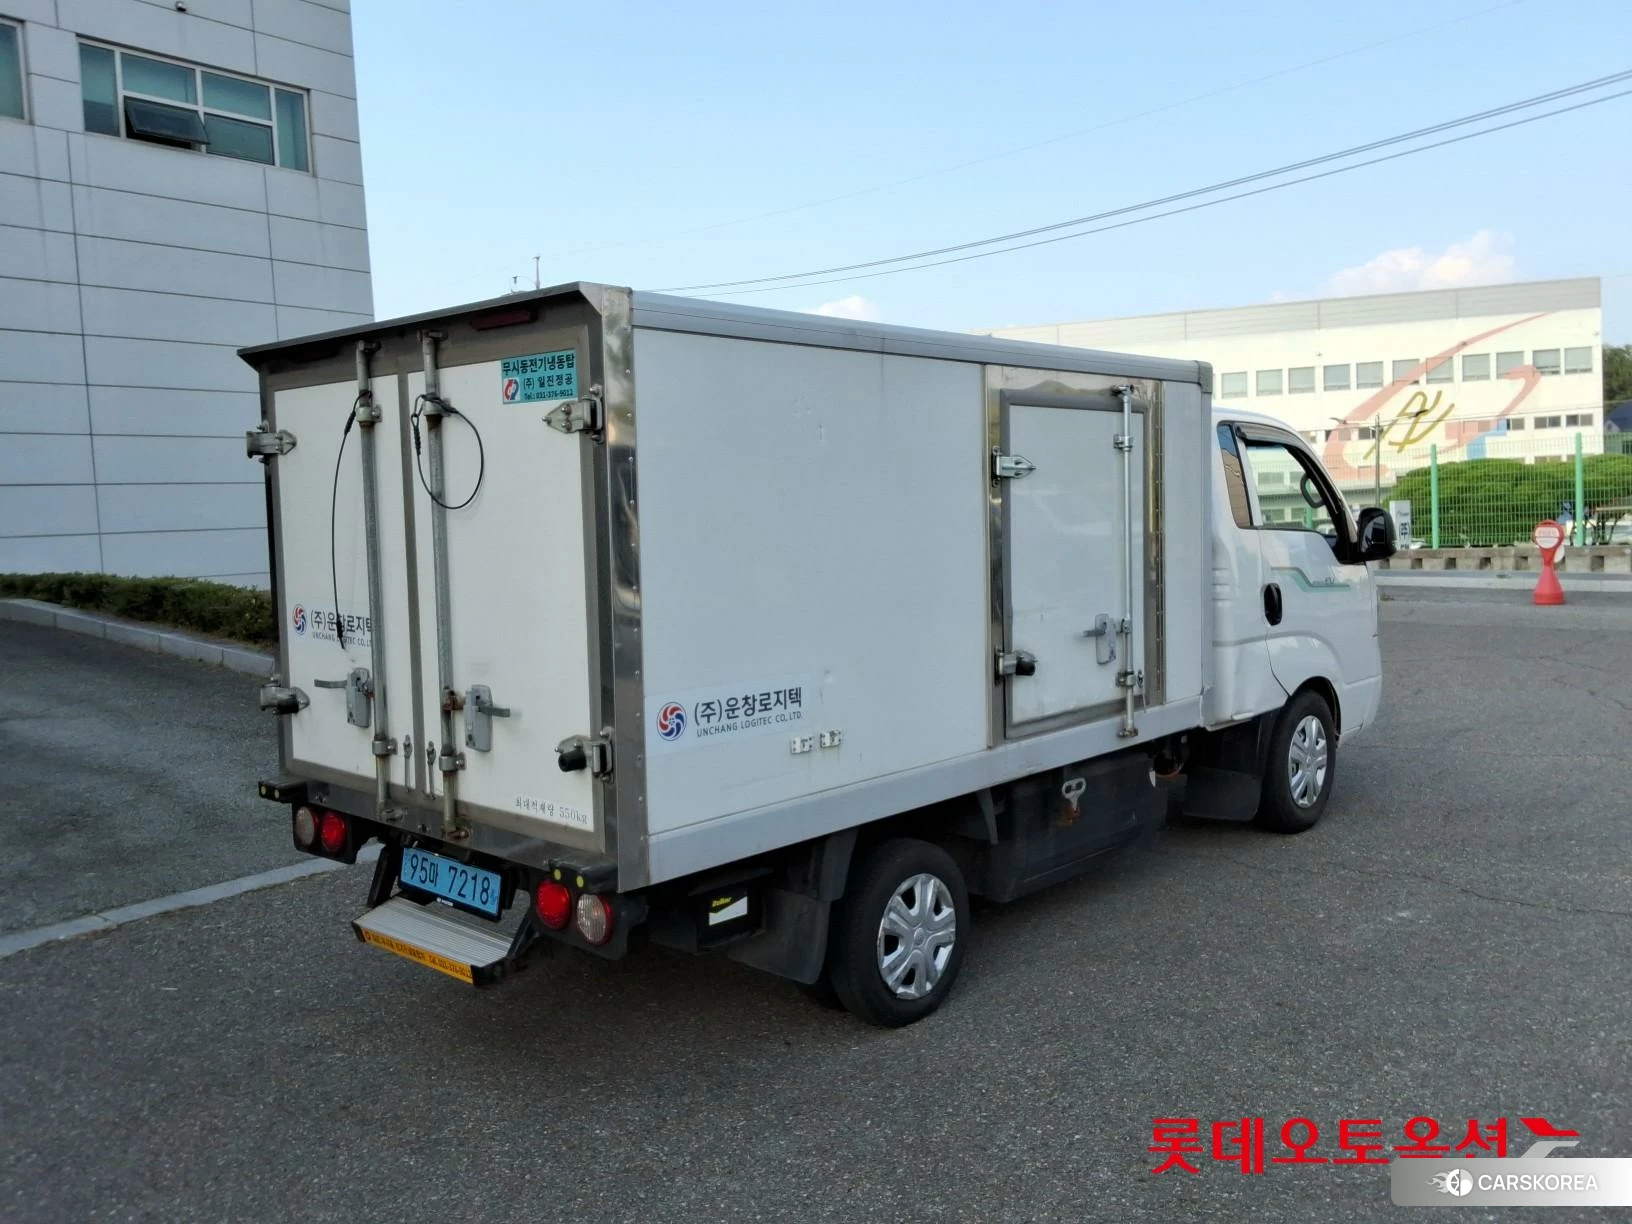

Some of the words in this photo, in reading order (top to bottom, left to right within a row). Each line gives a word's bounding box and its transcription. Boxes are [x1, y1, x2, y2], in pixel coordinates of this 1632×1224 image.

[694, 687, 802, 726] (주)운창로지텍
[696, 722, 738, 738] UNCHANG
[741, 716, 772, 730] LOGITEC
[559, 806, 588, 825] 550kg
[448, 865, 491, 905] 7218
